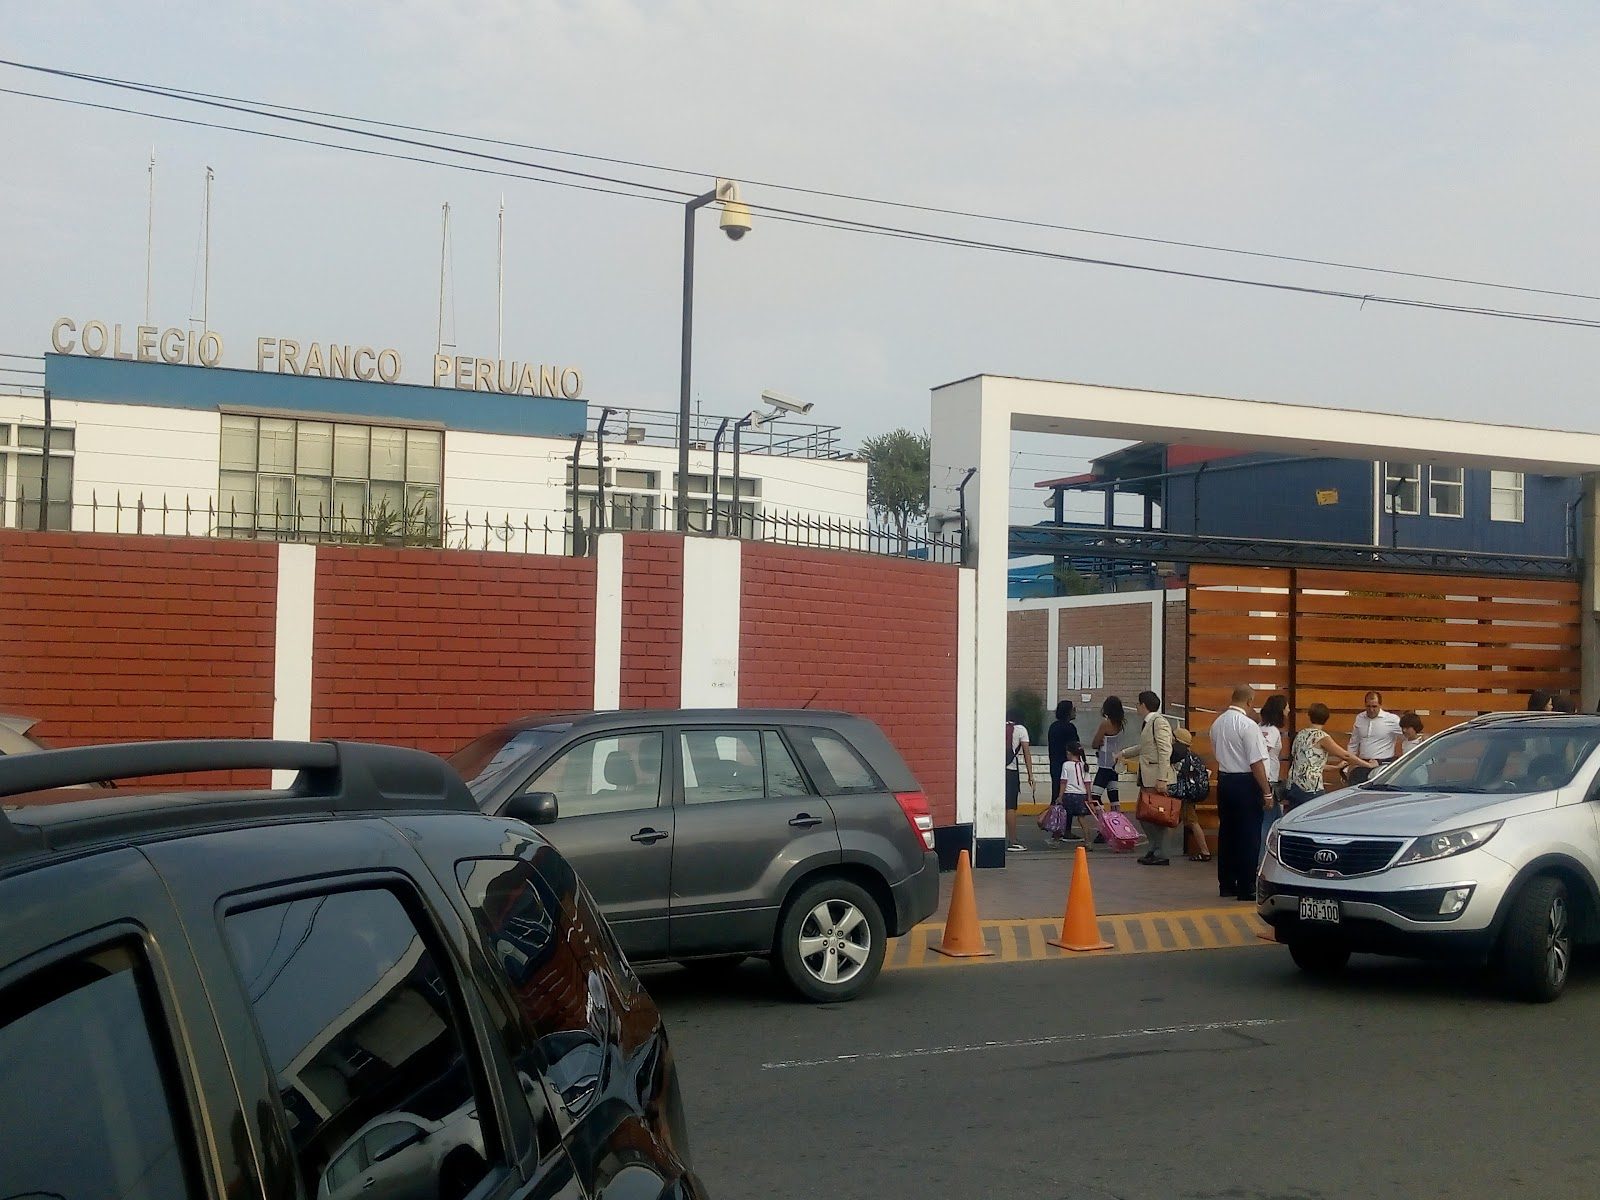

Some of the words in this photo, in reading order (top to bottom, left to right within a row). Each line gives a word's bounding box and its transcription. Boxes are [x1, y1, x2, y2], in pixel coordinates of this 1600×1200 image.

[51, 317, 224, 368] COLEGIO
[257, 336, 402, 384] FRANCO
[433, 352, 583, 399] PERUANO
[1316, 852, 1333, 862] KIA
